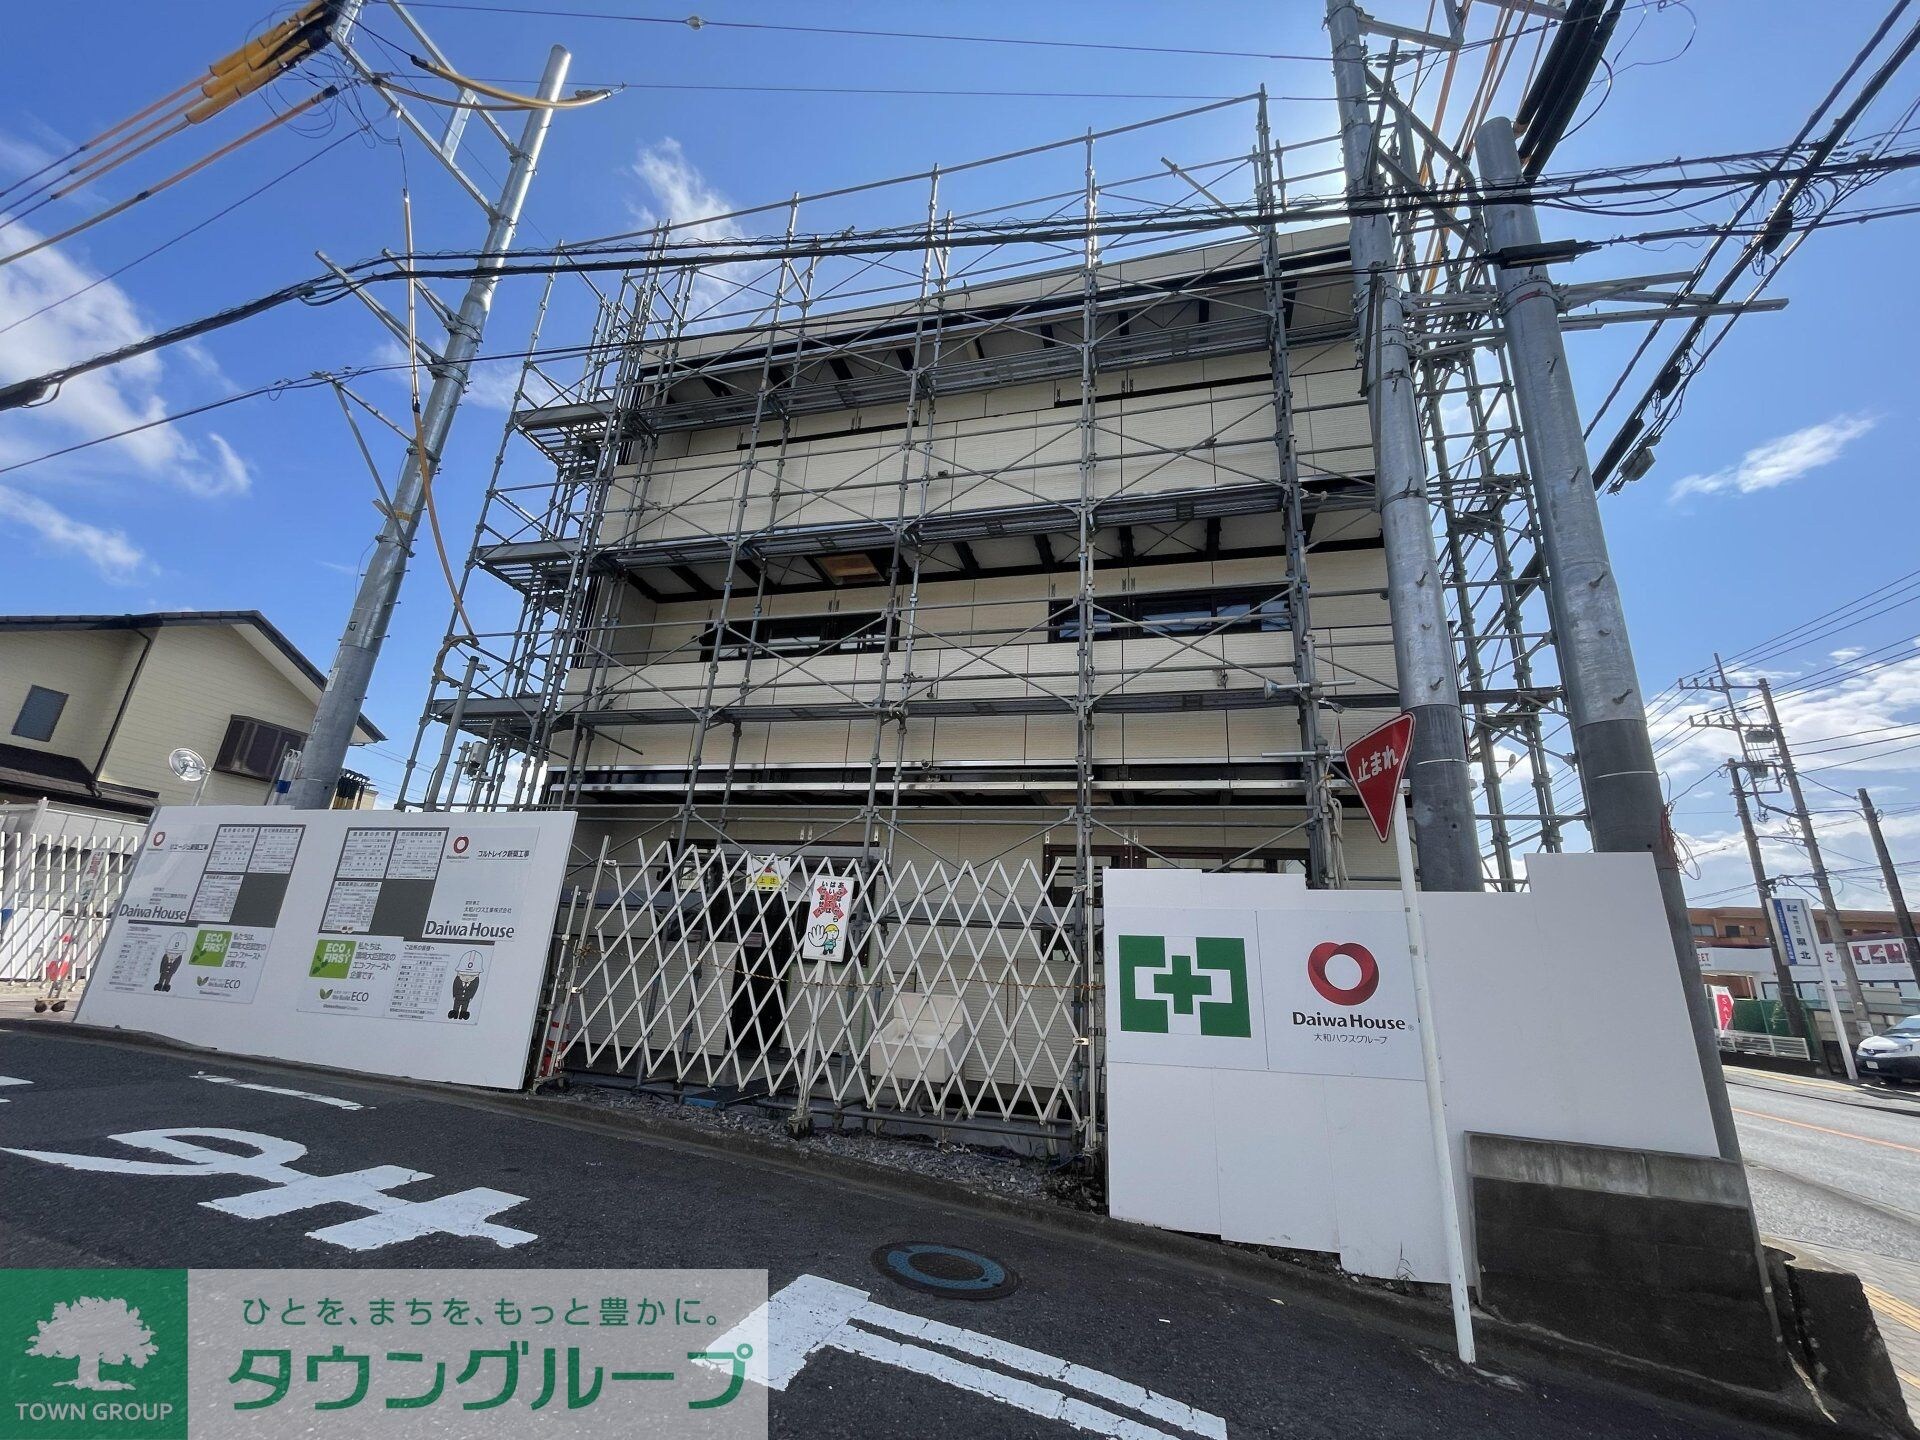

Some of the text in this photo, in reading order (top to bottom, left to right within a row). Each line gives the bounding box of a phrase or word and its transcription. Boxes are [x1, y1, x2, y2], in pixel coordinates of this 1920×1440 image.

[1358, 744, 1399, 783] 止まれ
[119, 904, 187, 920] Daiwa House
[425, 920, 515, 939] Daiwa House
[206, 933, 223, 942] ECO
[326, 943, 346, 953] ECO
[322, 953, 352, 964] FIRST
[224, 979, 241, 989] ECO
[351, 991, 369, 1002] ECO
[1292, 1011, 1406, 1030] Daiwa House
[1314, 1032, 1389, 1045] 大和ハウスグループ
